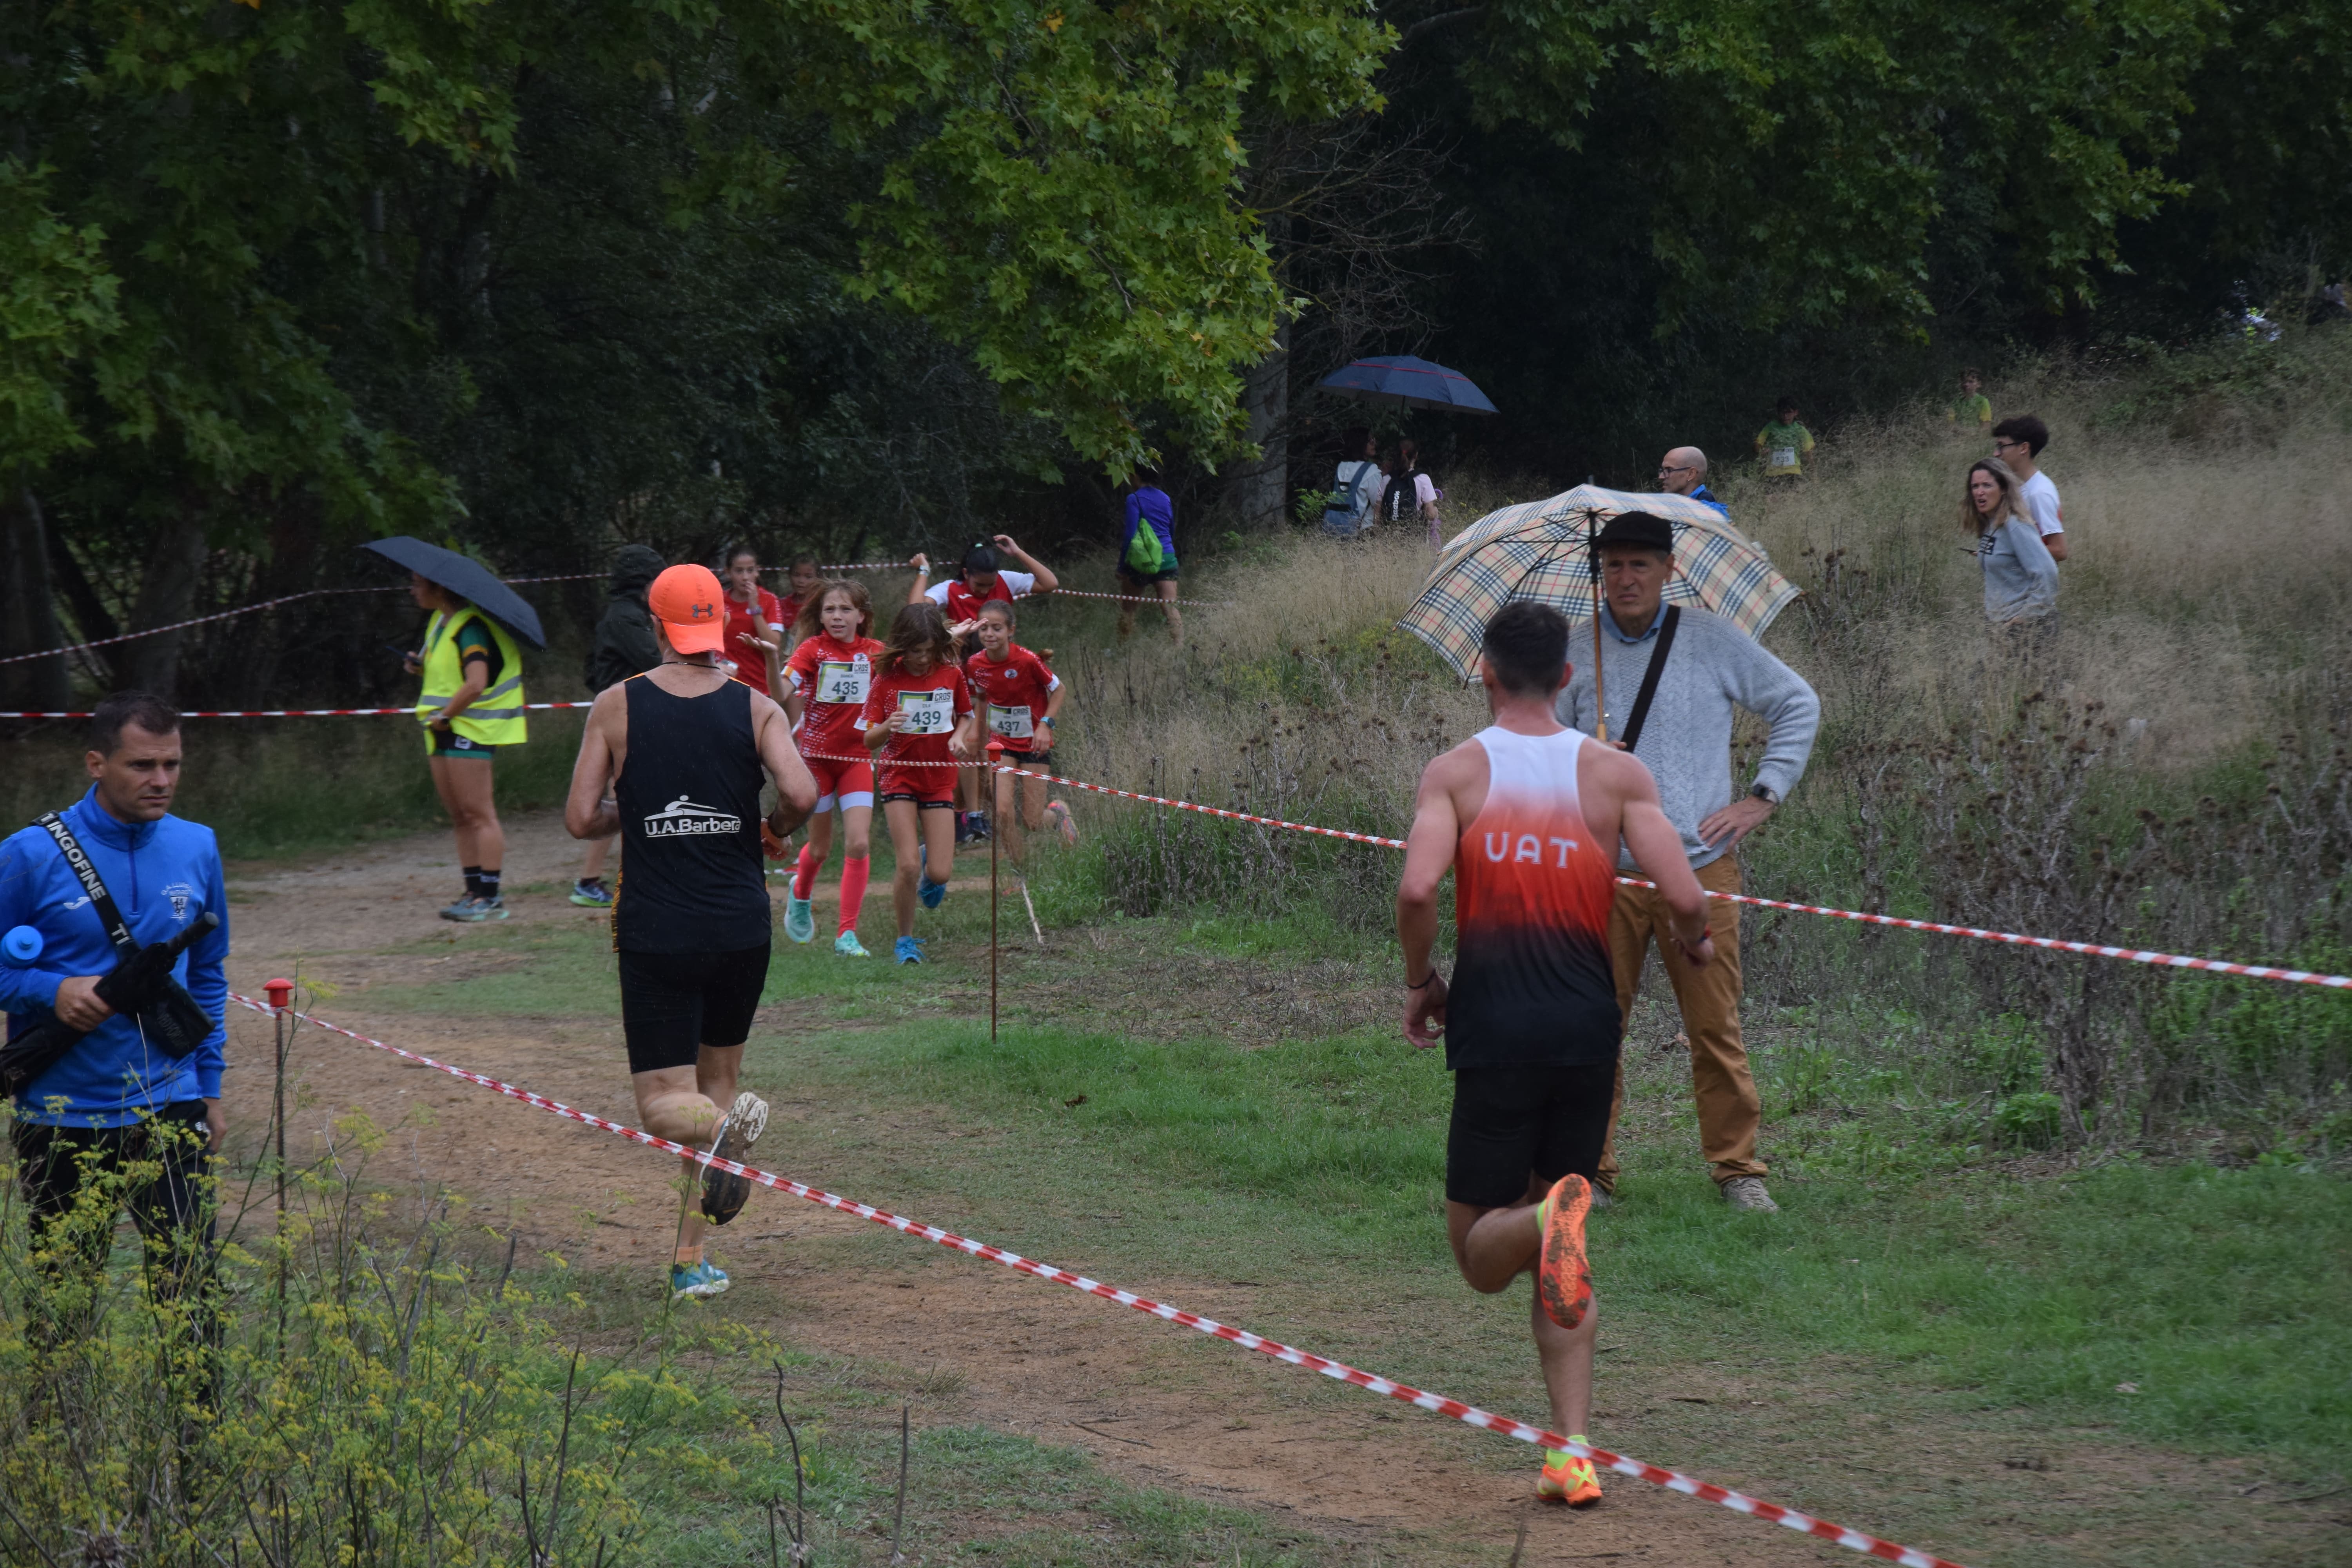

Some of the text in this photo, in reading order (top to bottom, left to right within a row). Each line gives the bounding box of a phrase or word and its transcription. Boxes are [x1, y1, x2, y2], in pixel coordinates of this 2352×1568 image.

[1392, 491, 1400, 521] Reebok
[831, 681, 859, 695] 435
[935, 692, 951, 701] CROS
[911, 711, 941, 725] 439
[997, 721, 1020, 731] 437
[1484, 831, 1579, 869] UAT
